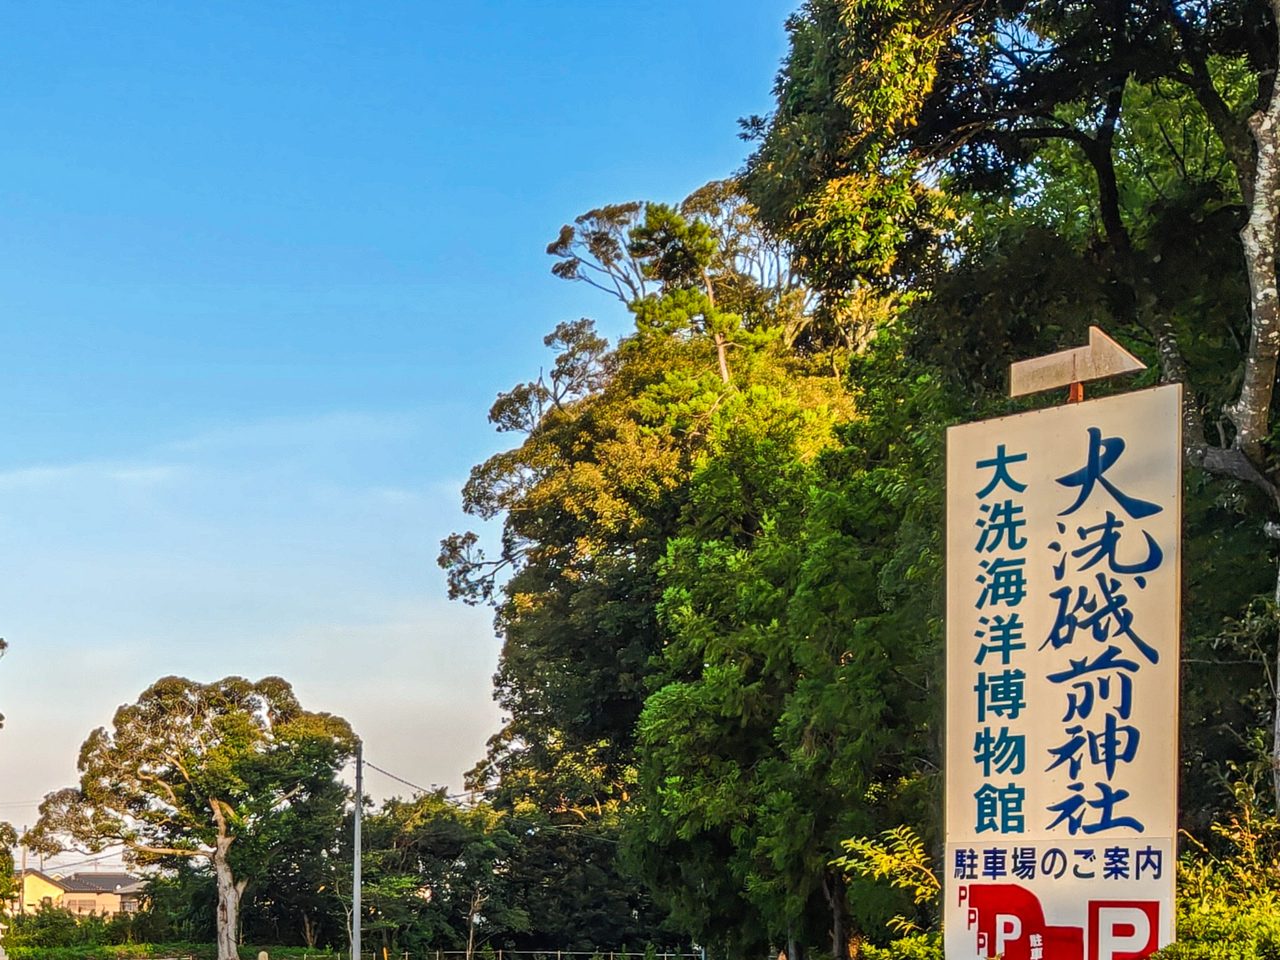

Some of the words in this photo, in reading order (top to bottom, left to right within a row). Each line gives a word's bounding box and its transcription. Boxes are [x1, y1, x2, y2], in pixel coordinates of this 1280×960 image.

[974, 444, 1028, 834] 大洗海洋博物館
[1038, 427, 1163, 835] 大洗磯前神社
[954, 846, 1162, 880] 駐車場のご案内
[995, 914, 1022, 957] P
